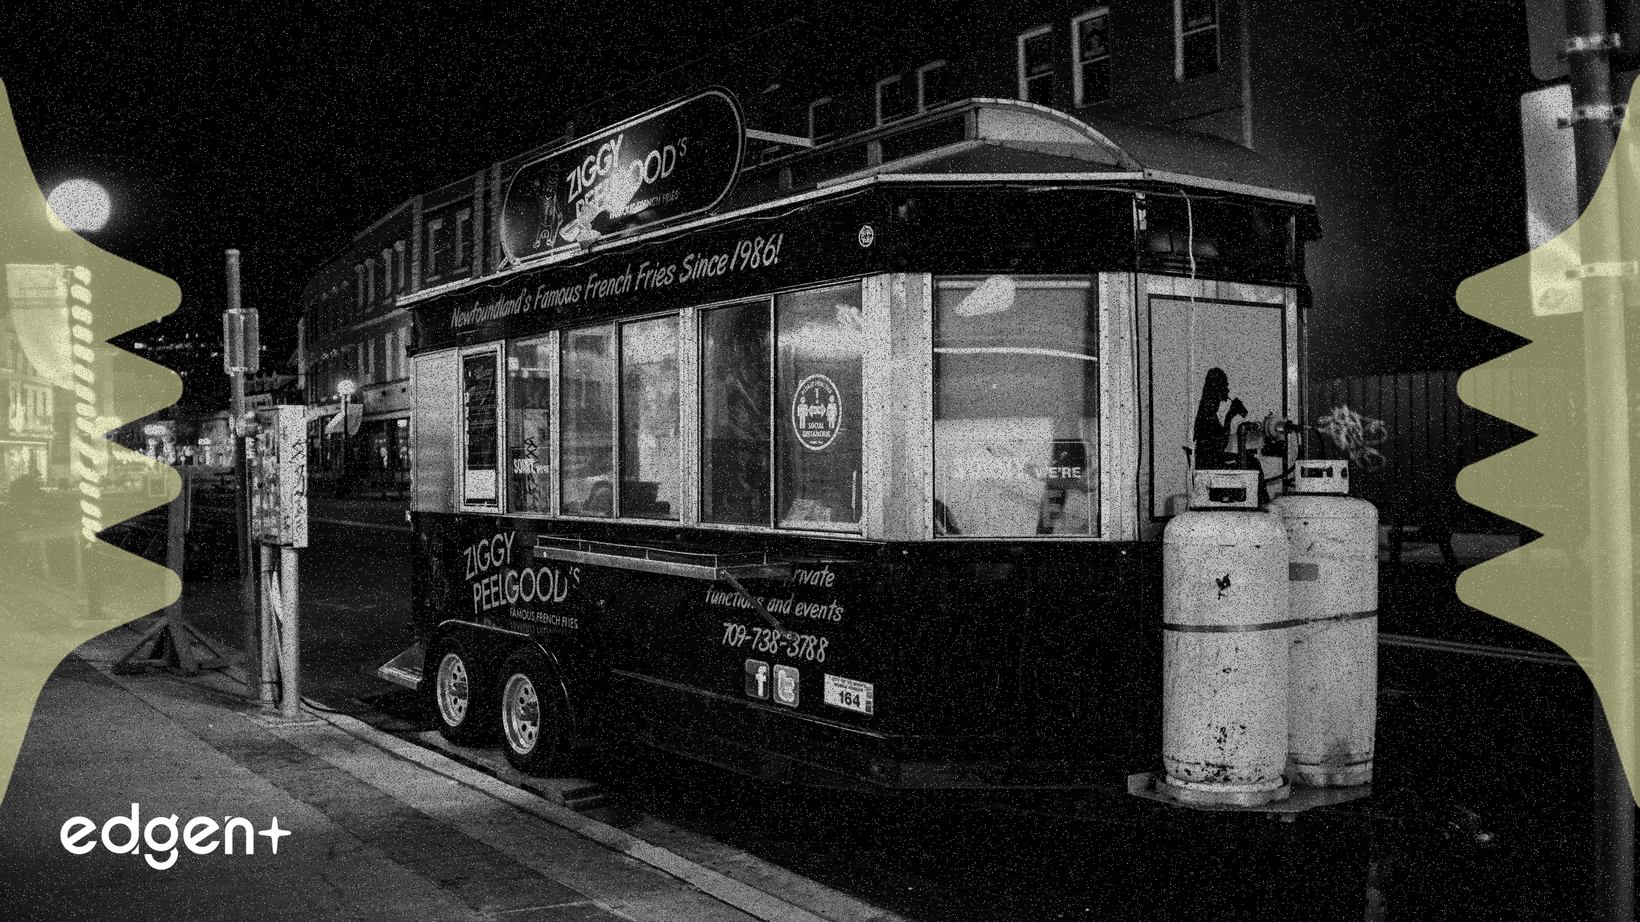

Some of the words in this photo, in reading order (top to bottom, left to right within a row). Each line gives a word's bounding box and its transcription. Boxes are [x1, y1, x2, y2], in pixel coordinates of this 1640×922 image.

[565, 133, 624, 203] ZIGGY
[451, 285, 531, 328] Newfoundland's
[533, 280, 582, 314] Famous
[583, 263, 633, 302] French
[635, 261, 675, 292] Fries
[679, 250, 727, 283] Since
[728, 233, 783, 272] 1986!
[463, 531, 516, 581] ZIGGY
[788, 565, 835, 588] rivate
[472, 566, 581, 614] PEELGOOD'S
[767, 592, 794, 615] and
[795, 599, 844, 623] events
[509, 608, 535, 623] FAMOUS
[535, 612, 561, 627] FRENCH
[722, 622, 829, 663] 709-738-3788
[839, 690, 860, 707] 164
